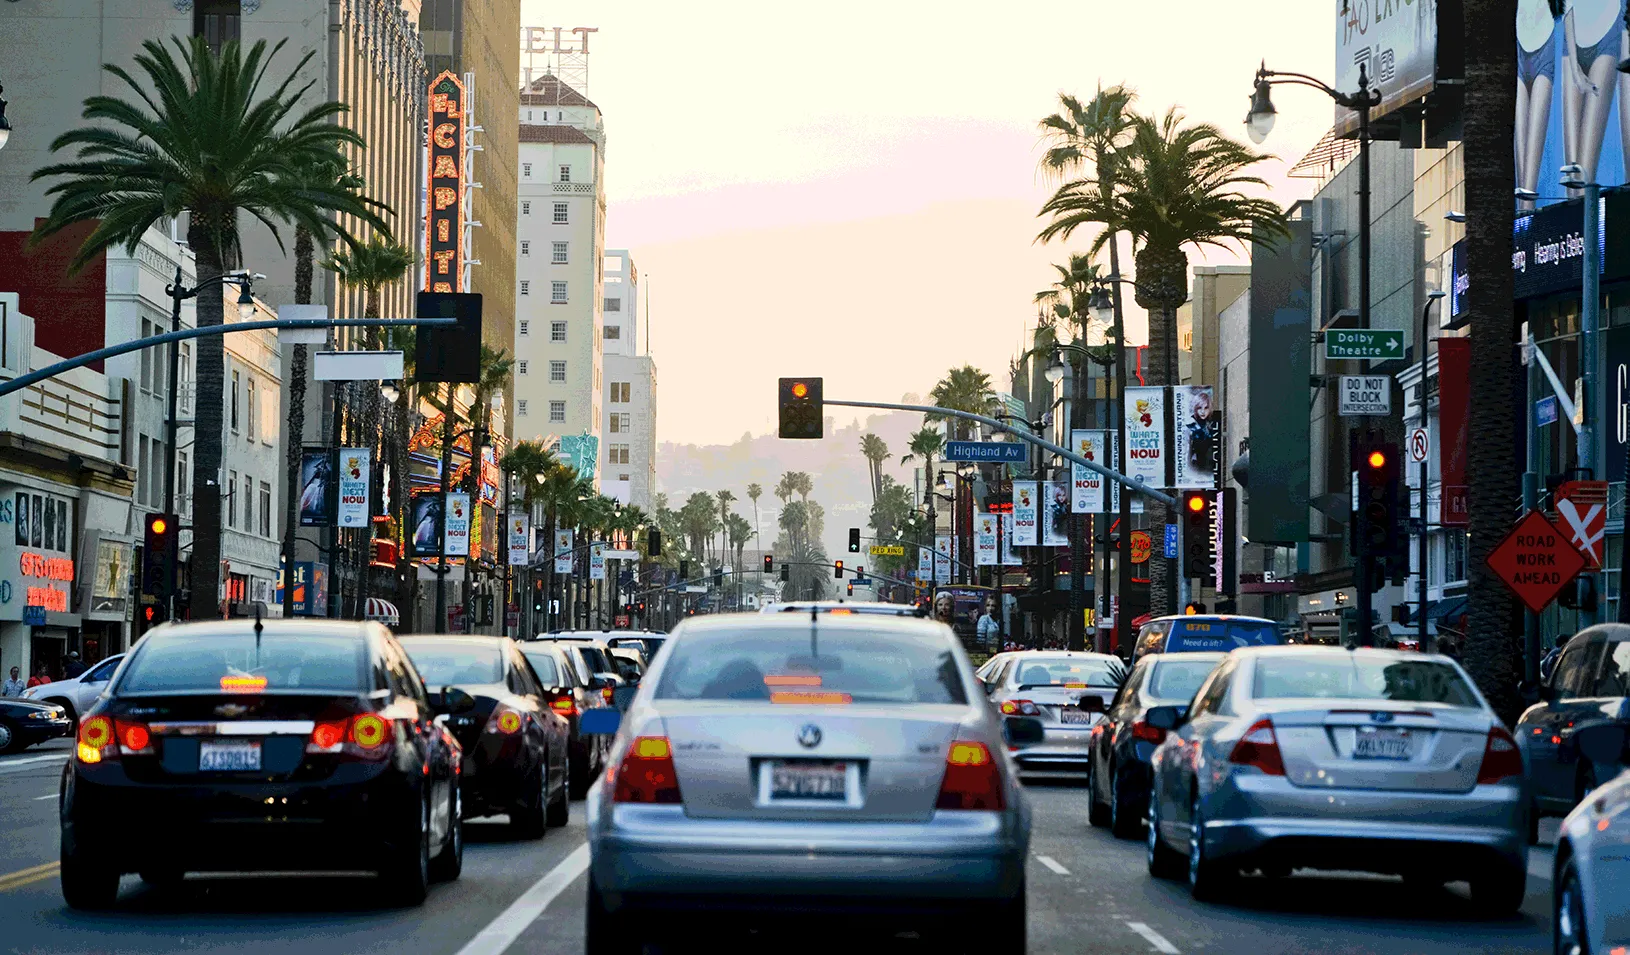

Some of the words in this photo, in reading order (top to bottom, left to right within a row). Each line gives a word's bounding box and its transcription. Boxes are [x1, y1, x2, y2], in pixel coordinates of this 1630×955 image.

[433, 93, 460, 119] EL
[1338, 333, 1375, 345] Dolby
[1331, 345, 1382, 356] Theatre
[1347, 378, 1361, 390] DO
[1364, 378, 1384, 390] NOT
[1349, 391, 1382, 403] BLOCK
[1343, 403, 1388, 412] INTERSECTION
[1129, 430, 1160, 438] WHAT'S
[1129, 439, 1160, 449] NEXT
[953, 445, 1000, 459] Highland
[1005, 446, 1019, 457] Av
[1129, 449, 1160, 459] NOW
[1075, 471, 1099, 480] NEXT
[1075, 480, 1100, 489] NOW
[342, 487, 366, 496] NEXT
[341, 496, 366, 504] NOW
[1516, 535, 1556, 548] ROAD
[1516, 553, 1556, 566] WORK
[1513, 572, 1561, 585] AHEAD
[26, 607, 46, 617] ATM
[1182, 639, 1202, 647] Need
